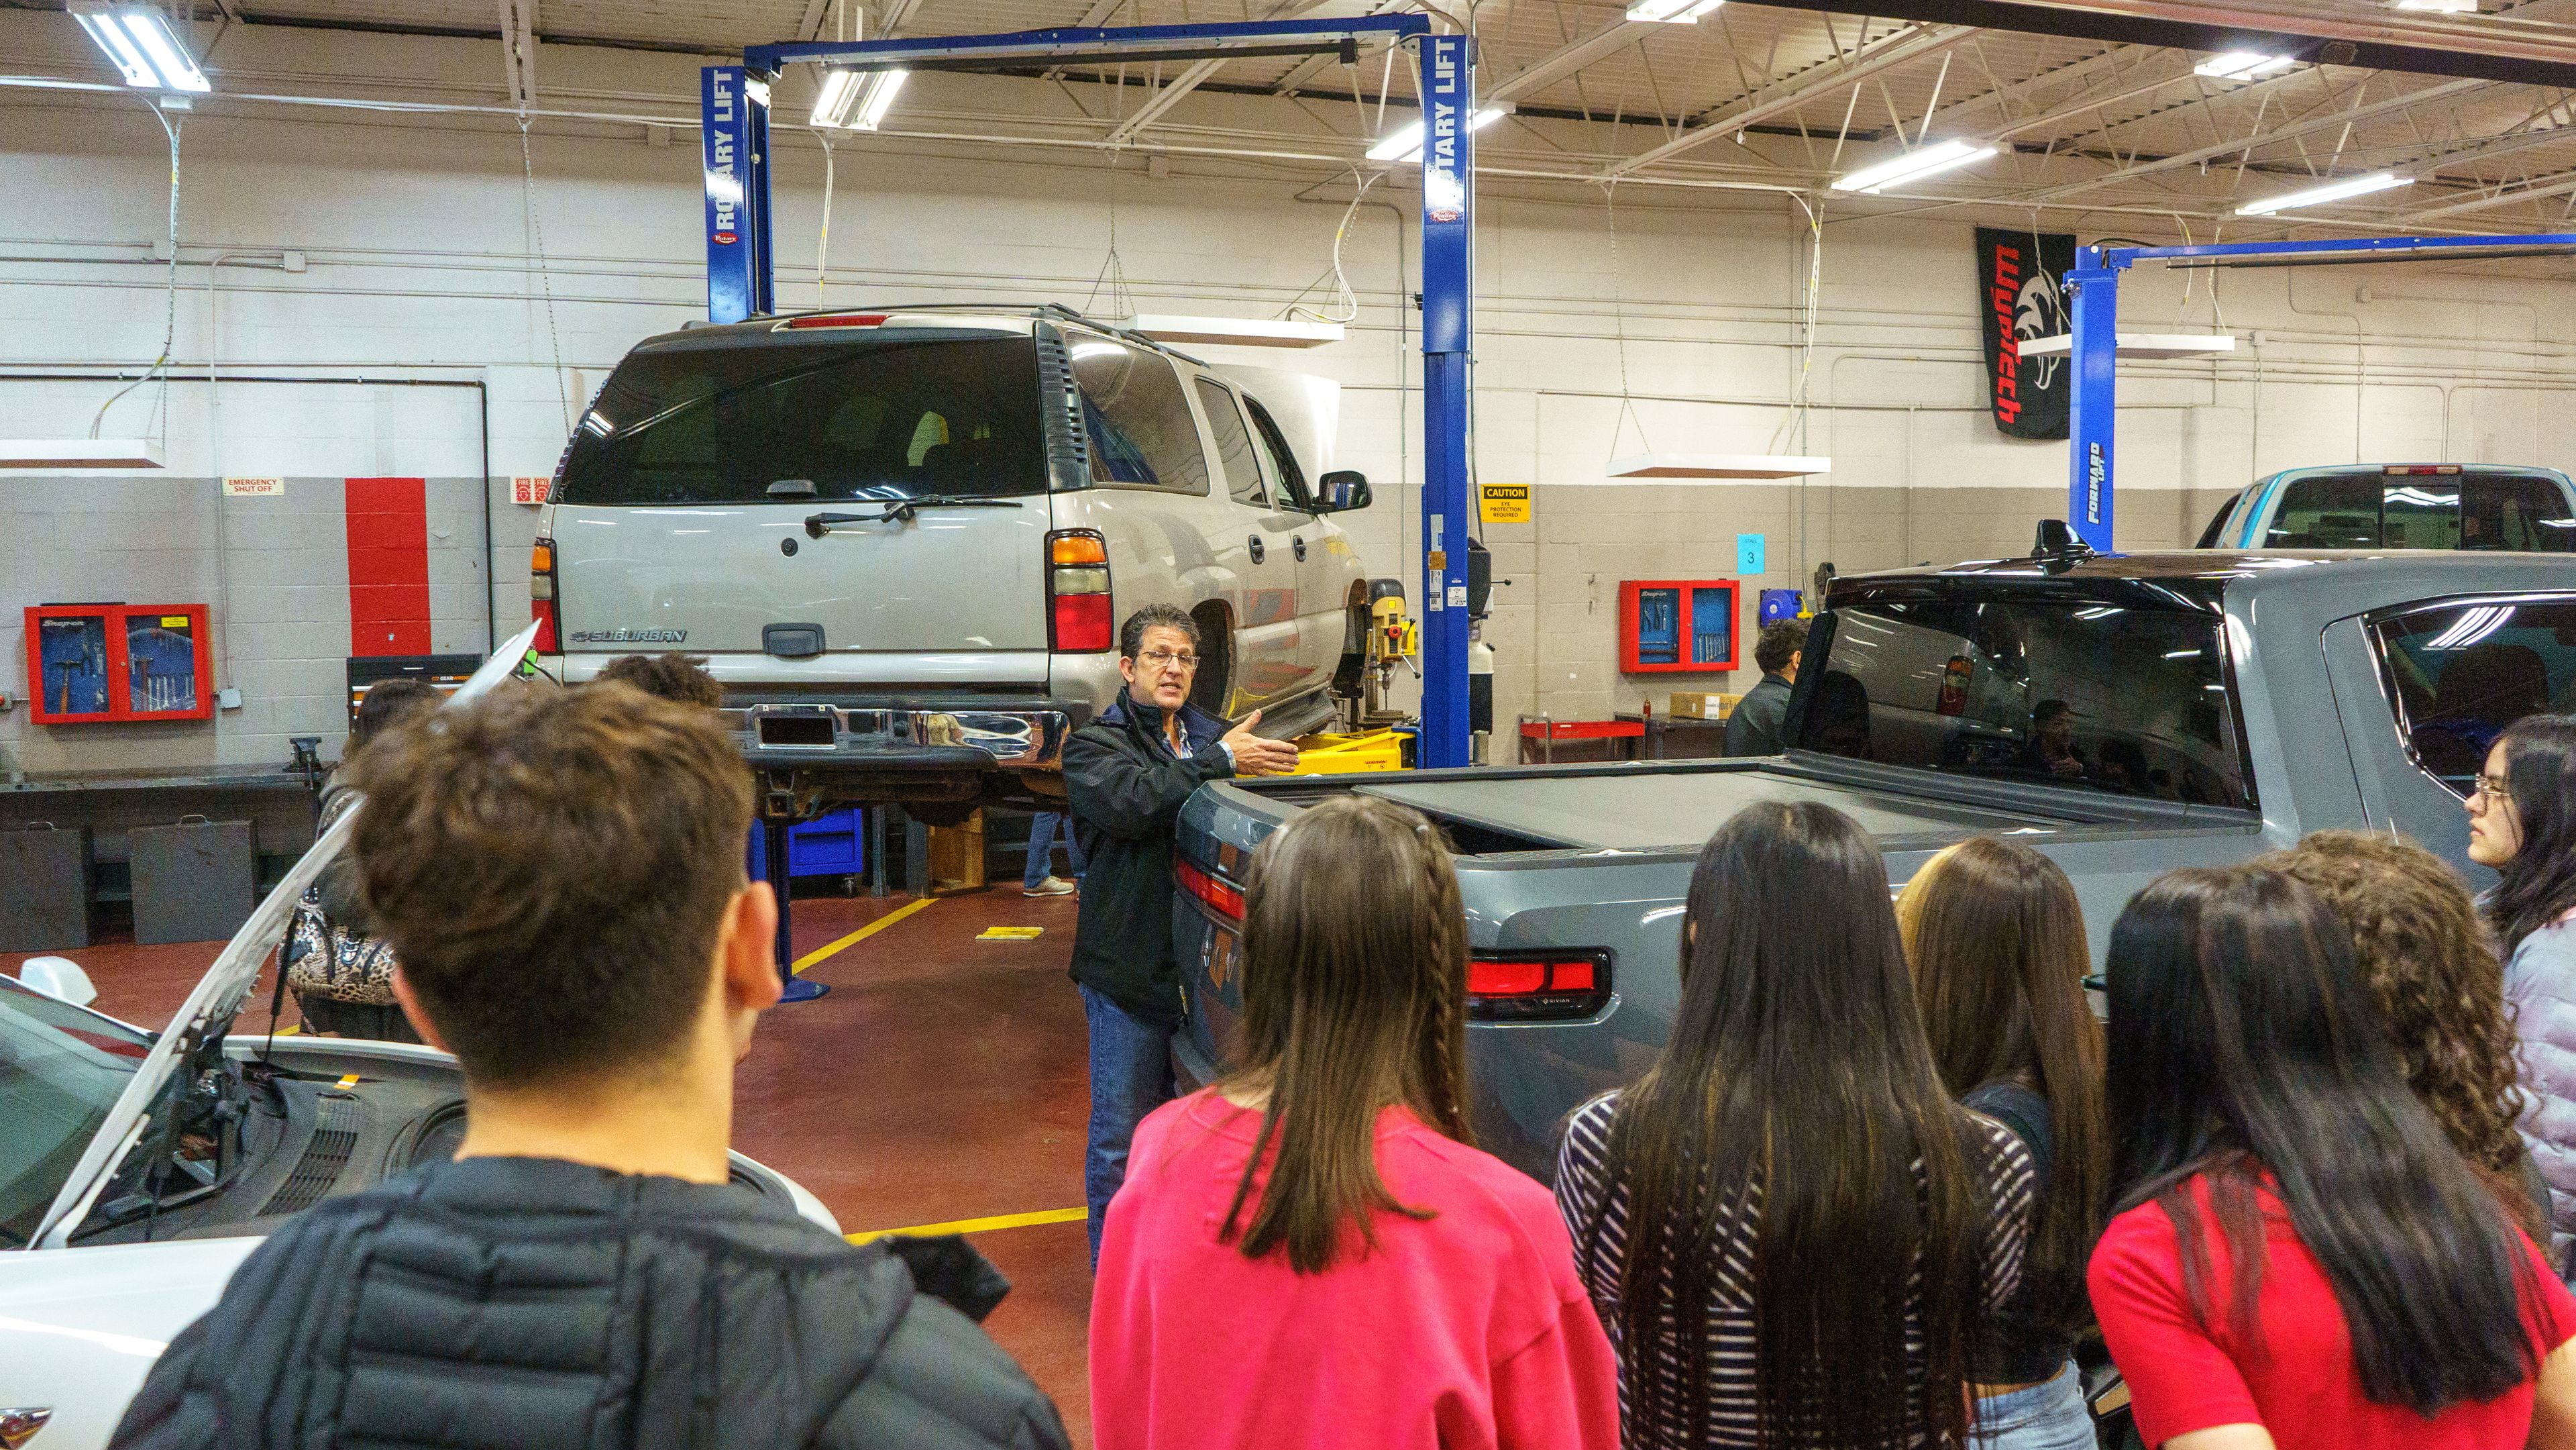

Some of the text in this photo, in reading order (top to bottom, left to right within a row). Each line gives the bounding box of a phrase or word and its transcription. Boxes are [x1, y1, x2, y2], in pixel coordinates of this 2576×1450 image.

[1435, 38, 1455, 93] LIFT
[714, 69, 735, 230] ROARY LIFT
[1487, 488, 1525, 497] CAUTION
[2088, 442, 2100, 524] FORWARD
[1748, 552, 1755, 564] 3
[590, 630, 688, 642] SUBURBAN
